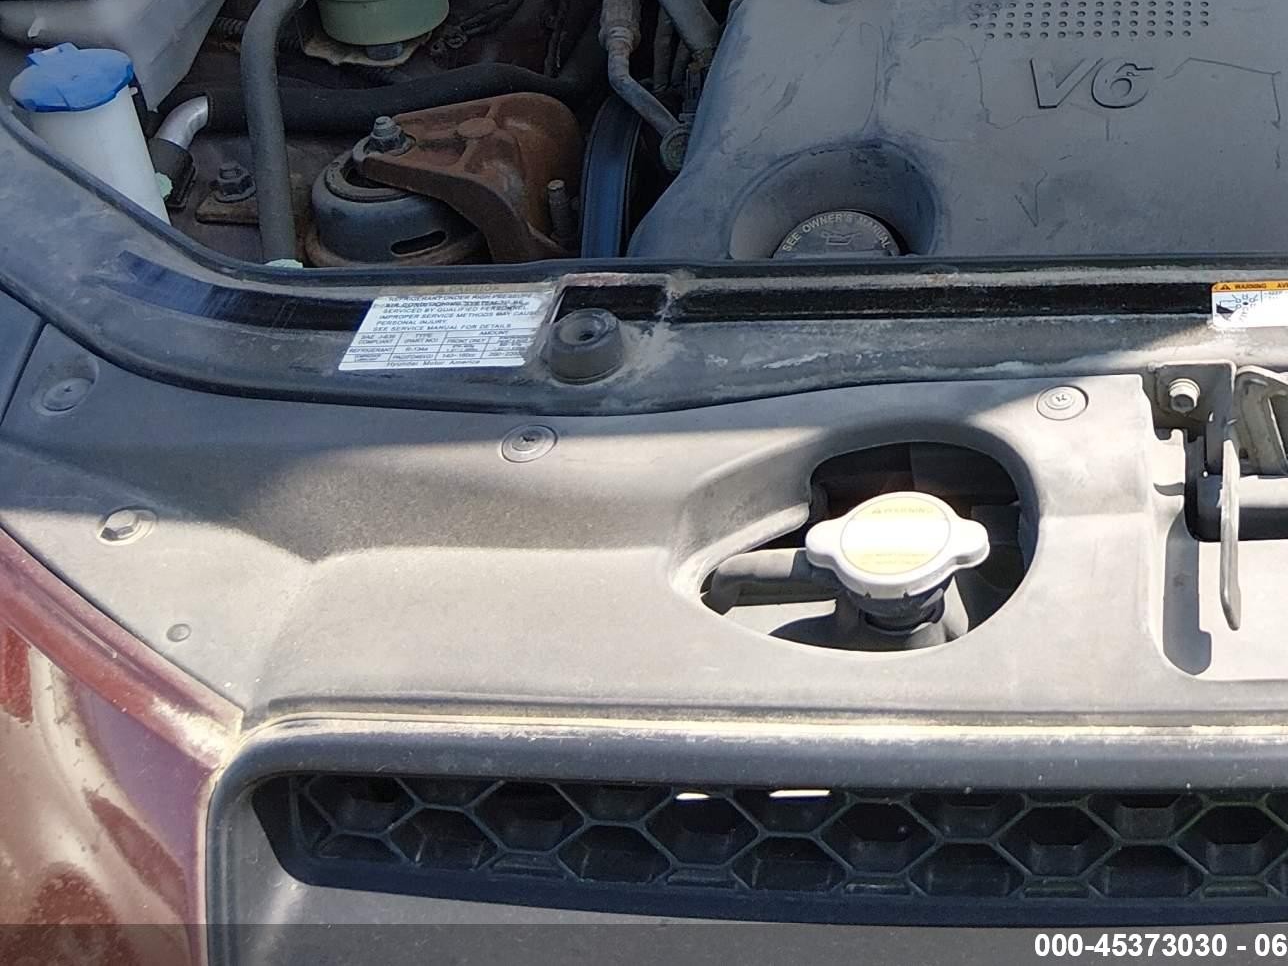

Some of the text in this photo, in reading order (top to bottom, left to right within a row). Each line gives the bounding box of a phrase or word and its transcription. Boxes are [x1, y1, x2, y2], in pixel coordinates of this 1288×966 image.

[1029, 58, 1155, 110] V6
[782, 214, 892, 252] SEE OWNER'S MANUAL
